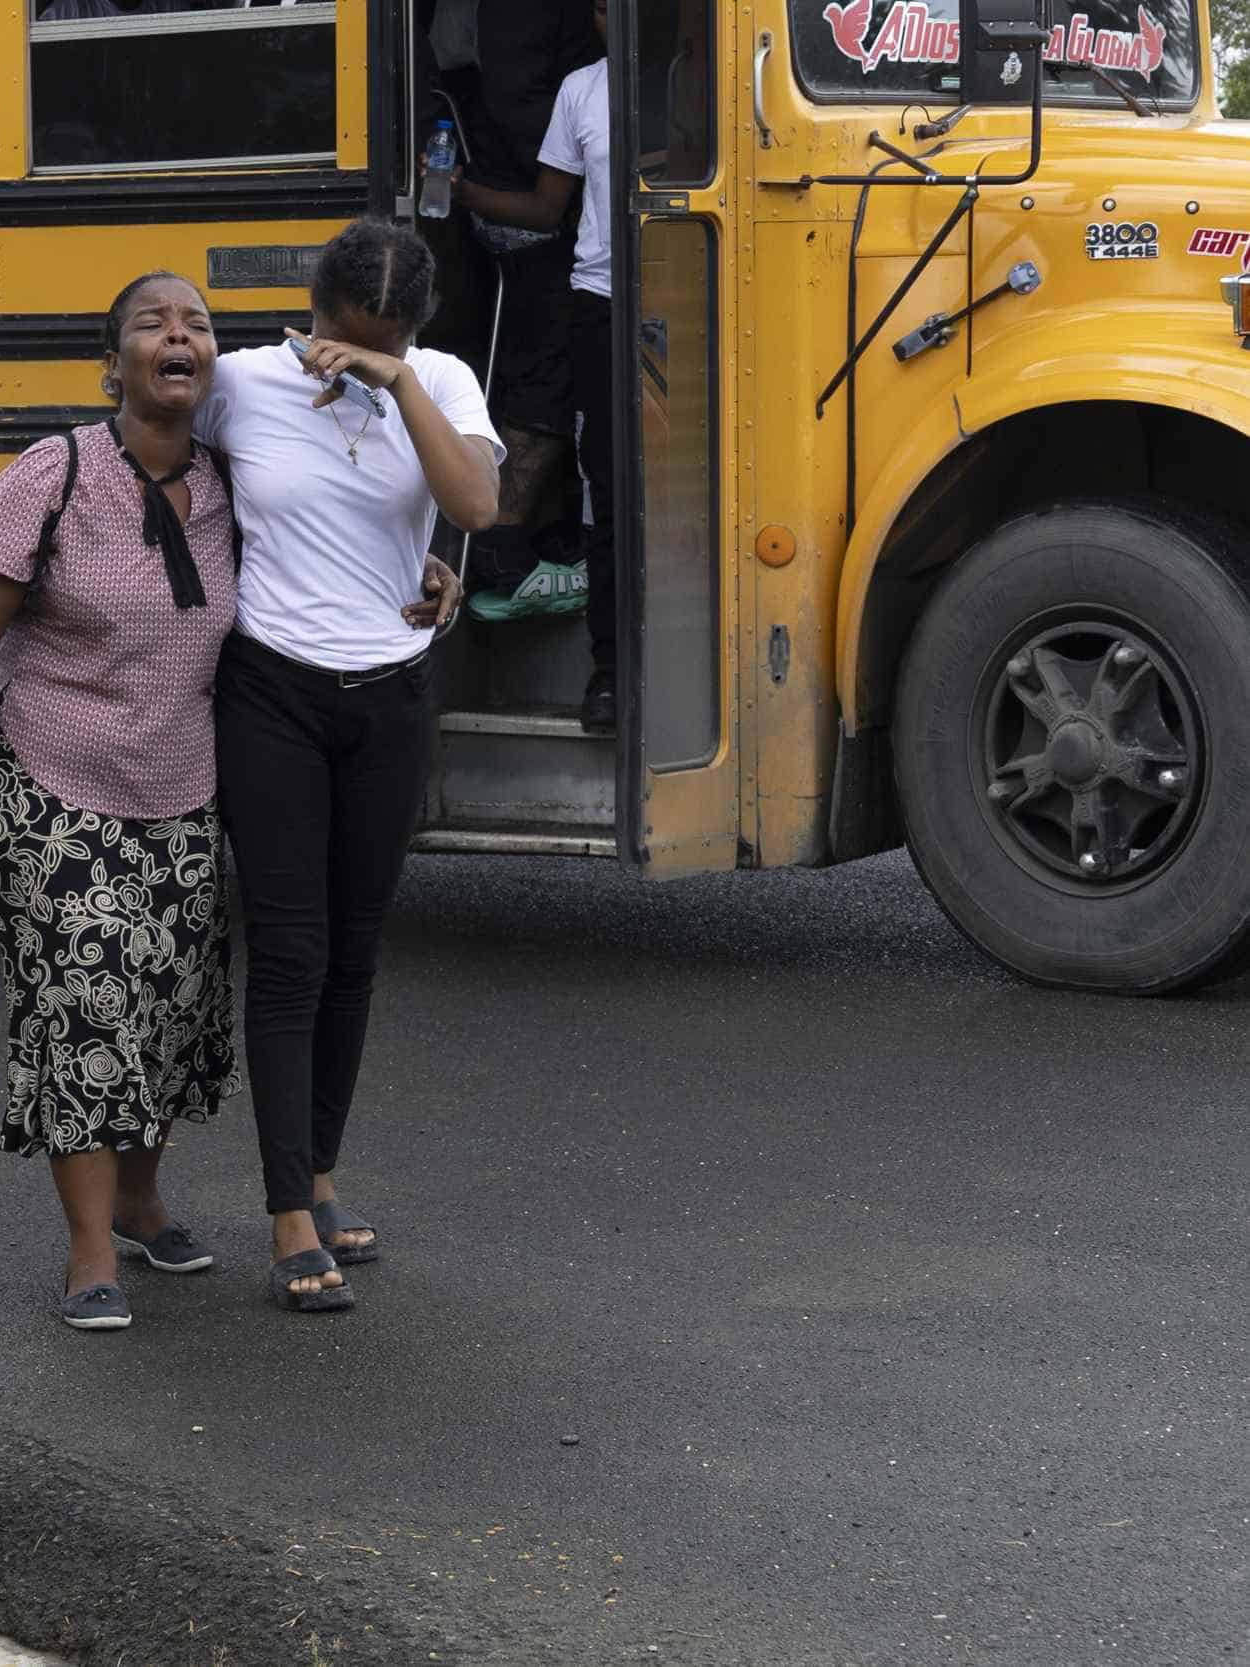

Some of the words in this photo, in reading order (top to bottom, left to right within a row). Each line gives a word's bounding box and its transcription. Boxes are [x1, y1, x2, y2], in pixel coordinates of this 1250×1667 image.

[1086, 223, 1158, 244] 3800
[1187, 228, 1250, 256] car
[1086, 246, 1099, 257] T
[1103, 245, 1158, 257] 444E
